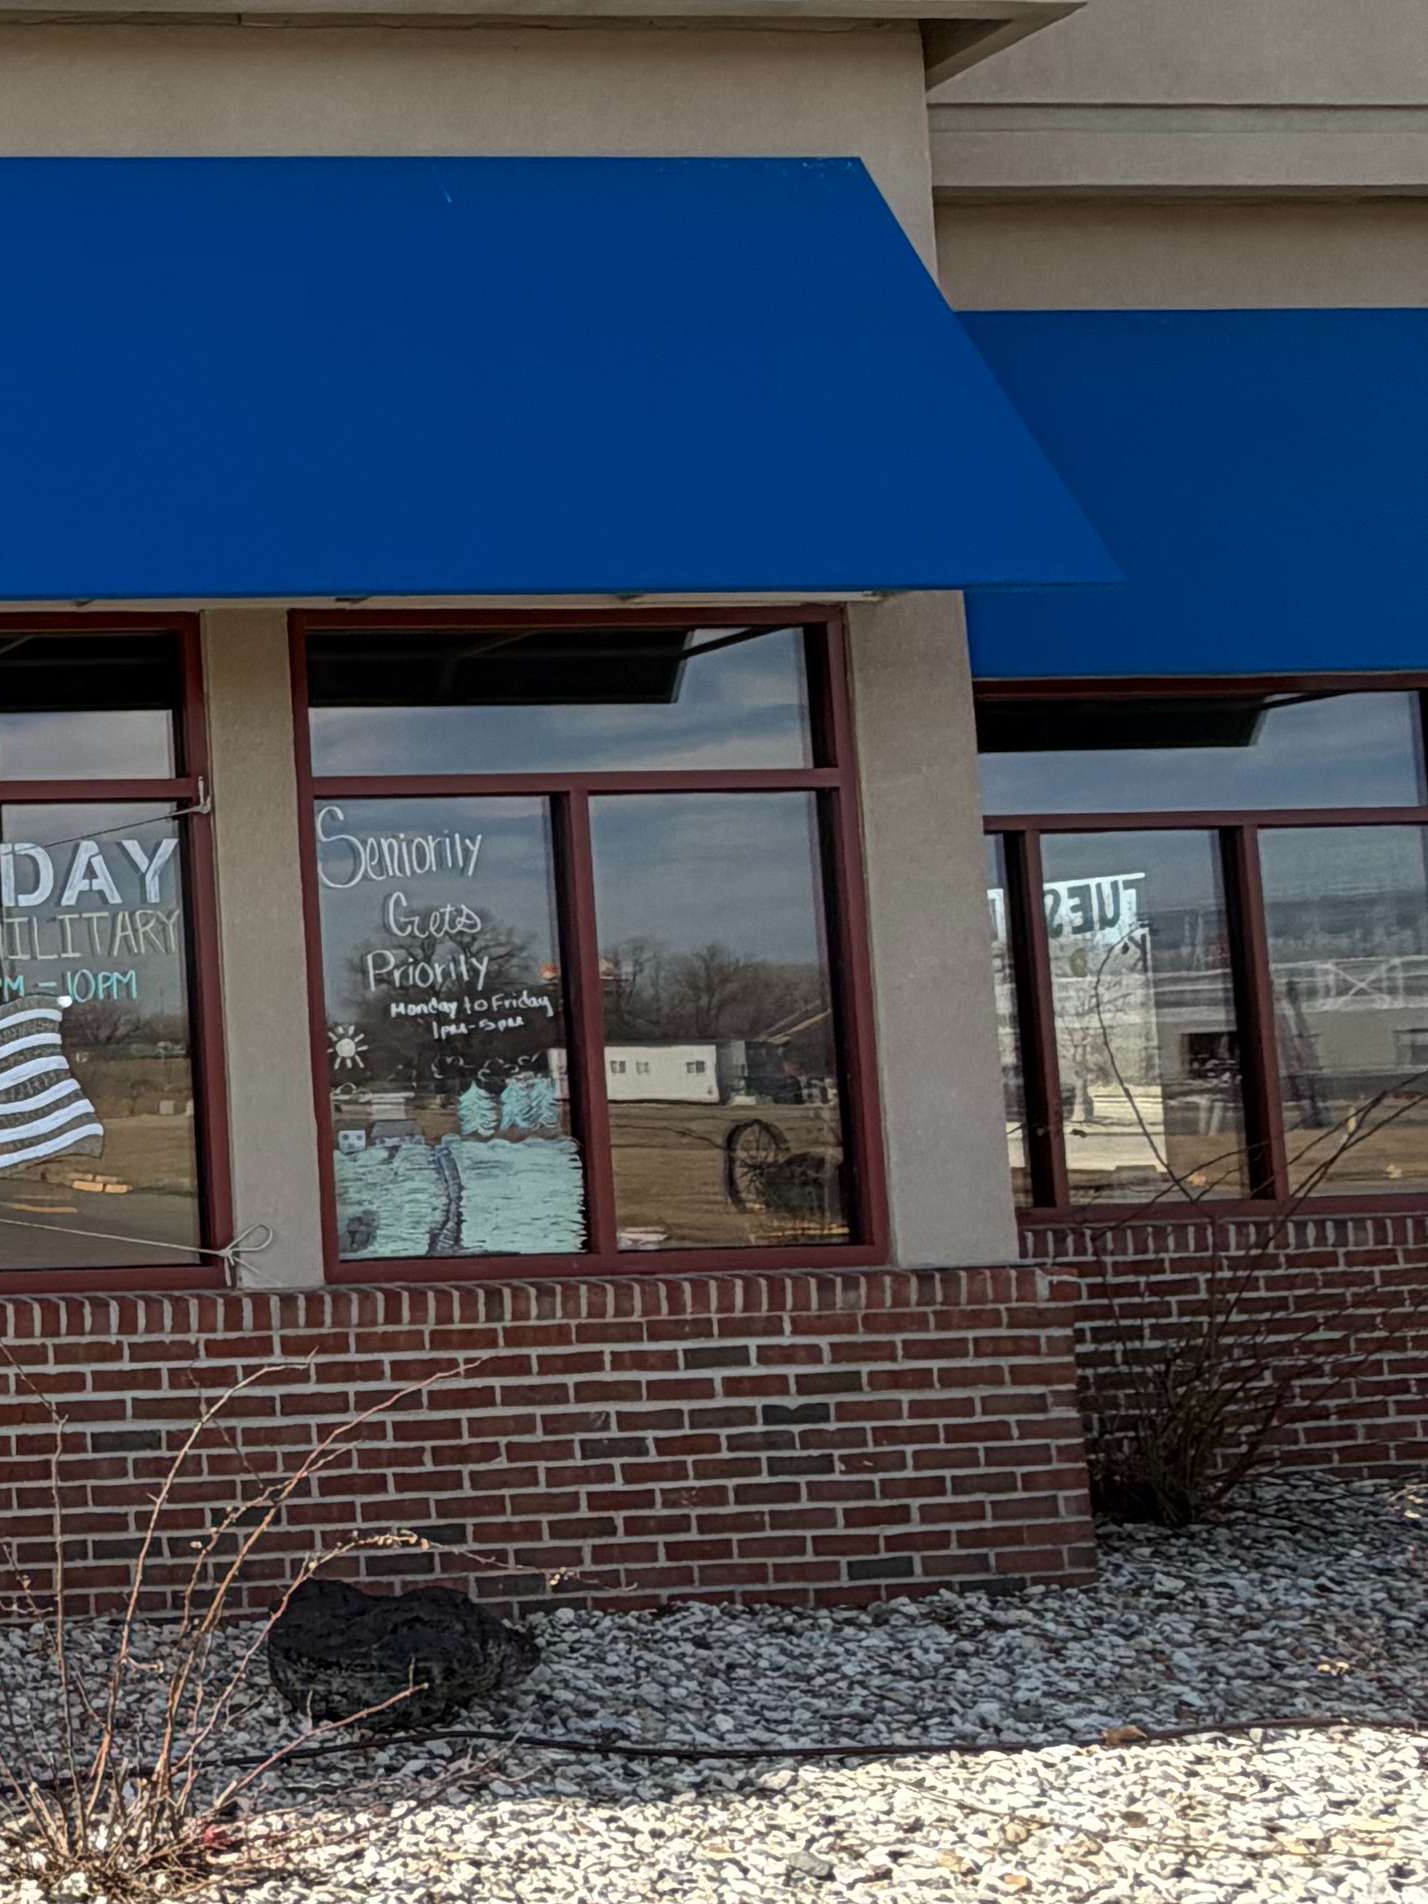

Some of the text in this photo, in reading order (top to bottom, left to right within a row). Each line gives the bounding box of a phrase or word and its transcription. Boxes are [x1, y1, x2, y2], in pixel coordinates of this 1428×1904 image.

[388, 892, 481, 938] Gets
[66, 968, 137, 1004] 10PM
[390, 989, 554, 1019] Monday to Friday
